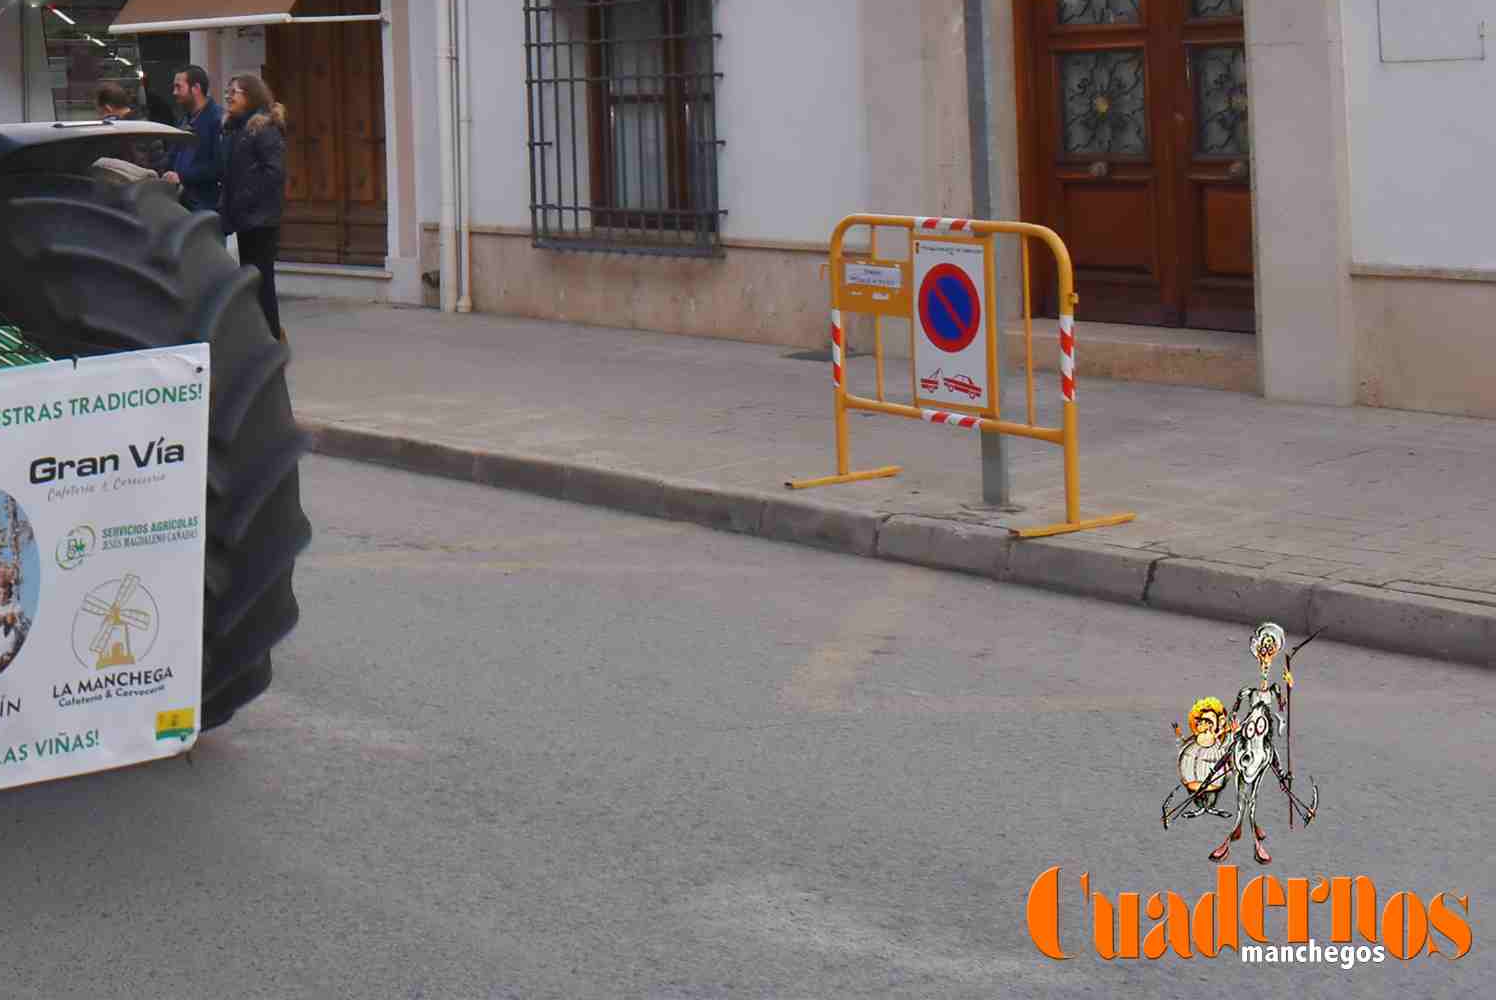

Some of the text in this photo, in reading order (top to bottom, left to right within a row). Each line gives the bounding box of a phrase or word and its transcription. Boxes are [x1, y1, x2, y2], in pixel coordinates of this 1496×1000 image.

[68, 383, 203, 417] TRADICIONES!
[29, 436, 186, 485] Gran Vía
[52, 666, 174, 698] LA MANCHEGA
[34, 729, 100, 758] VIÑAS!
